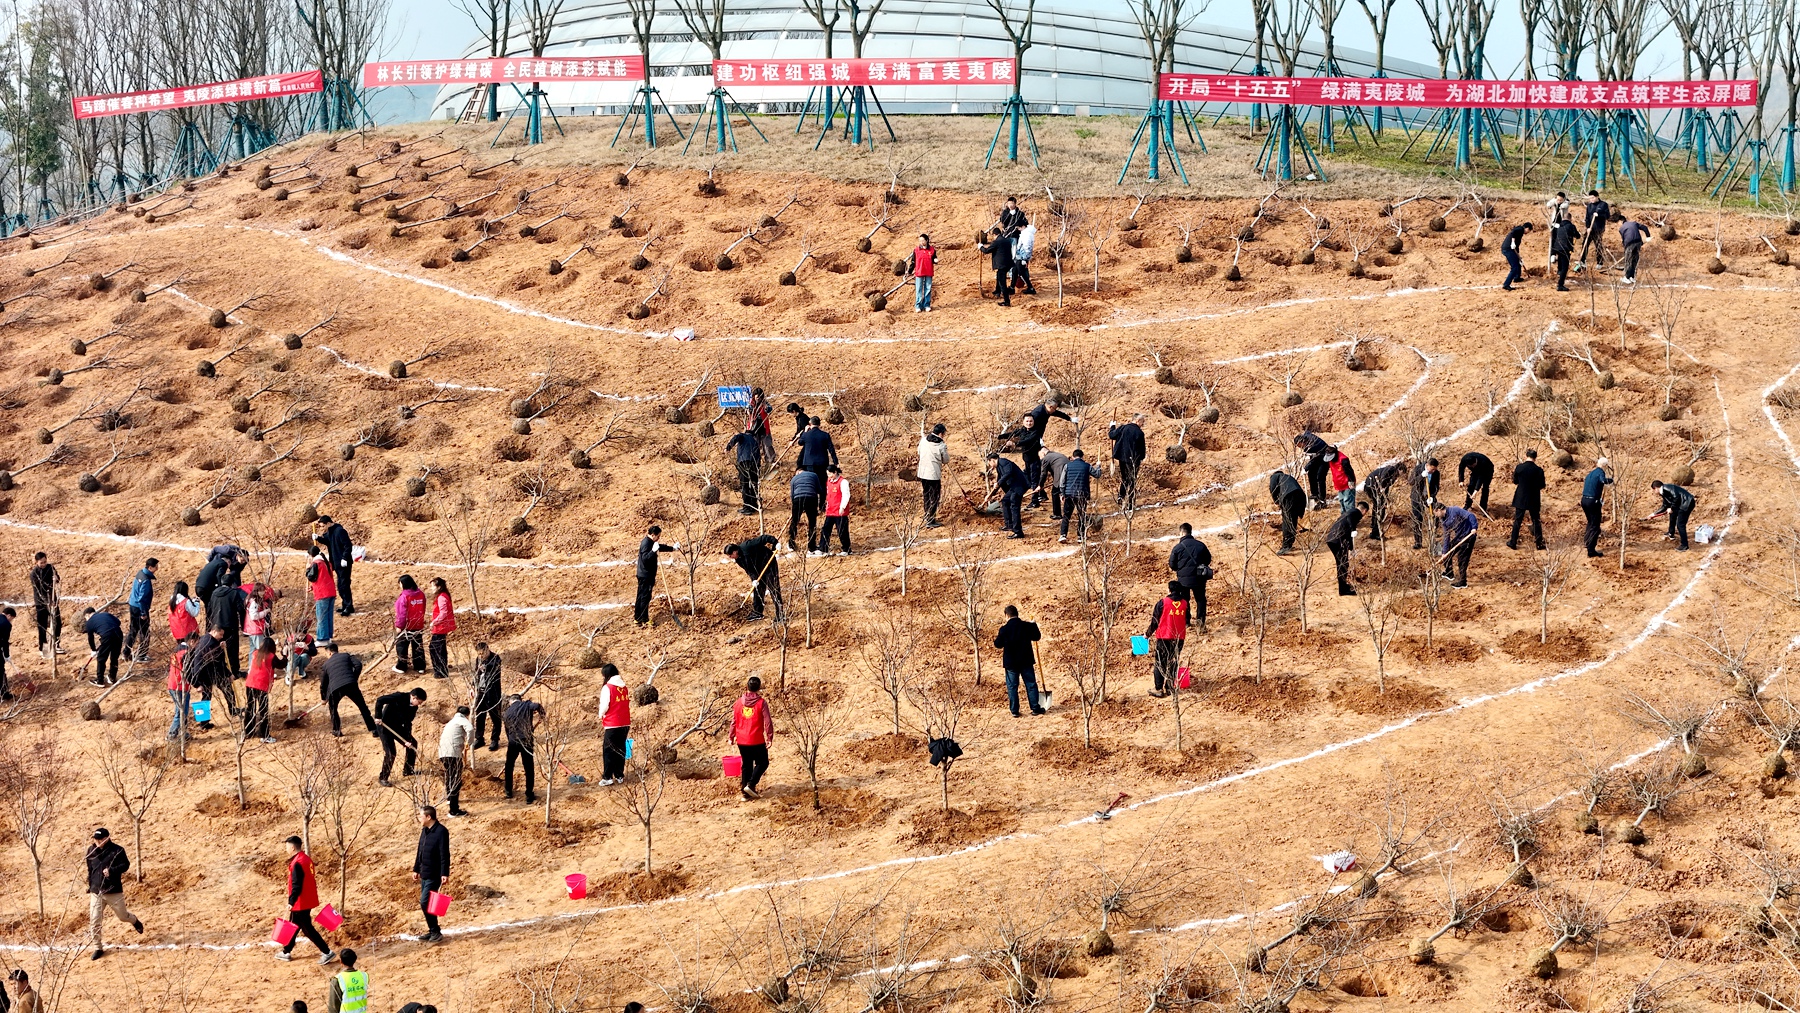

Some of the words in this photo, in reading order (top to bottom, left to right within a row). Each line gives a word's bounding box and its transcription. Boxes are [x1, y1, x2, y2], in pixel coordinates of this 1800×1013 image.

[377, 61, 493, 82] 林长引领护绿增碳
[503, 59, 627, 79] 全民植树添彩赋能
[716, 62, 850, 82] 建功枢纽强城
[868, 61, 1012, 81] 绿满富美夷陵
[81, 92, 175, 114] 马蹄催春种希望
[183, 78, 282, 102] 夷陵添绿谱新篇
[1168, 77, 1302, 99] 开局“十五五”
[1321, 81, 1426, 102] 绿满夷陵城
[1445, 84, 1751, 104] 为湖北加快建成支点筑牢生态屏障
